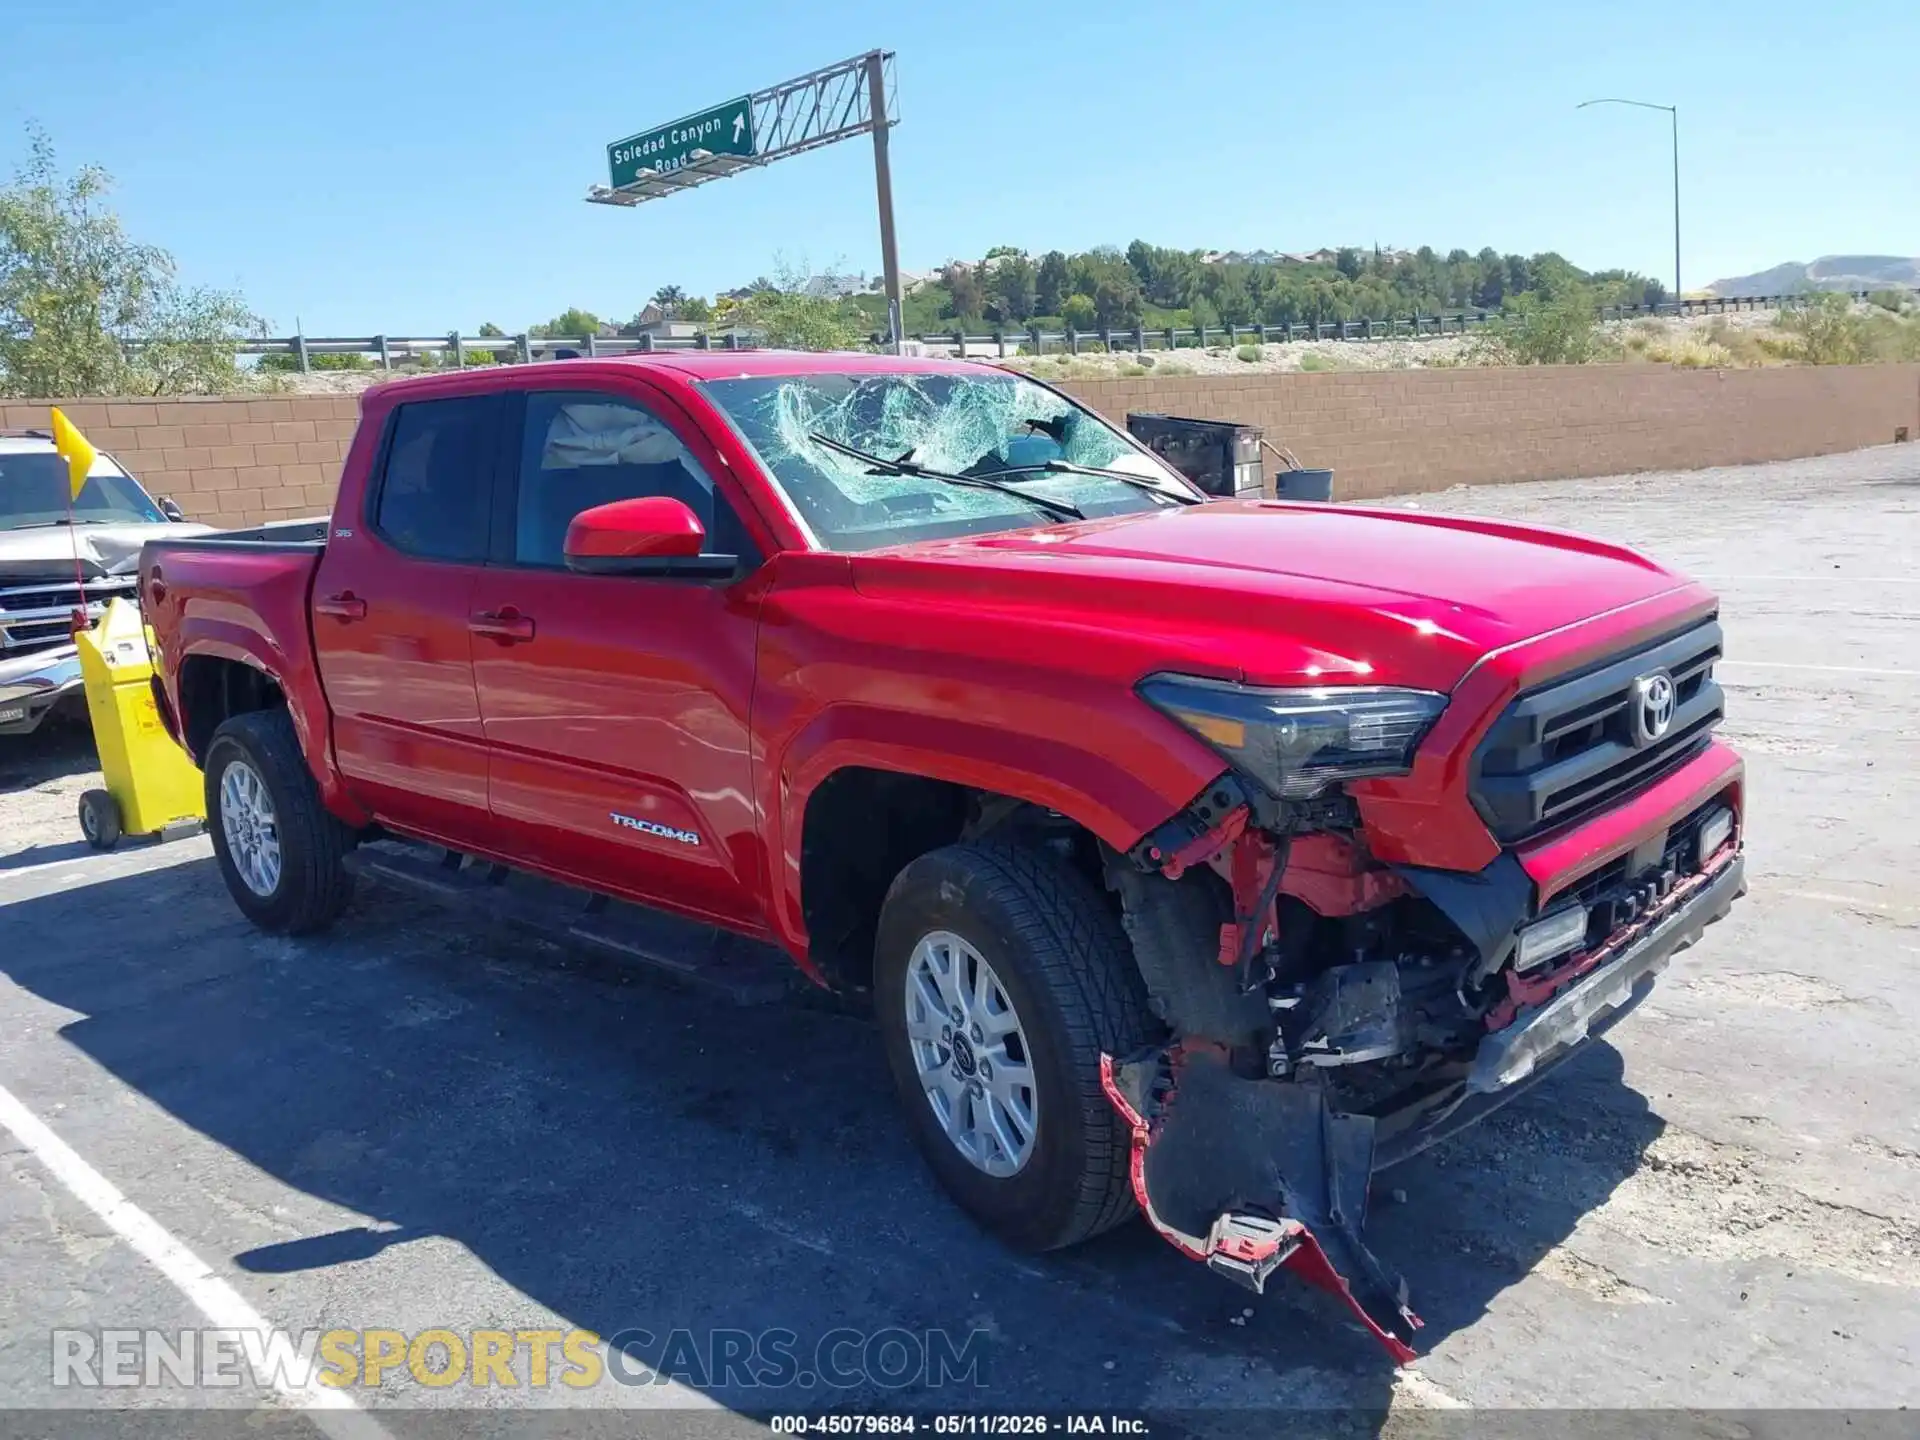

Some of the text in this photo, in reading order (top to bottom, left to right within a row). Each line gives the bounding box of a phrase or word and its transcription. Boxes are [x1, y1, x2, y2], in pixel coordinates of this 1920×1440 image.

[614, 118, 721, 165] Soledad Canyon
[655, 152, 687, 174] Road
[609, 812, 700, 846] TACOMA
